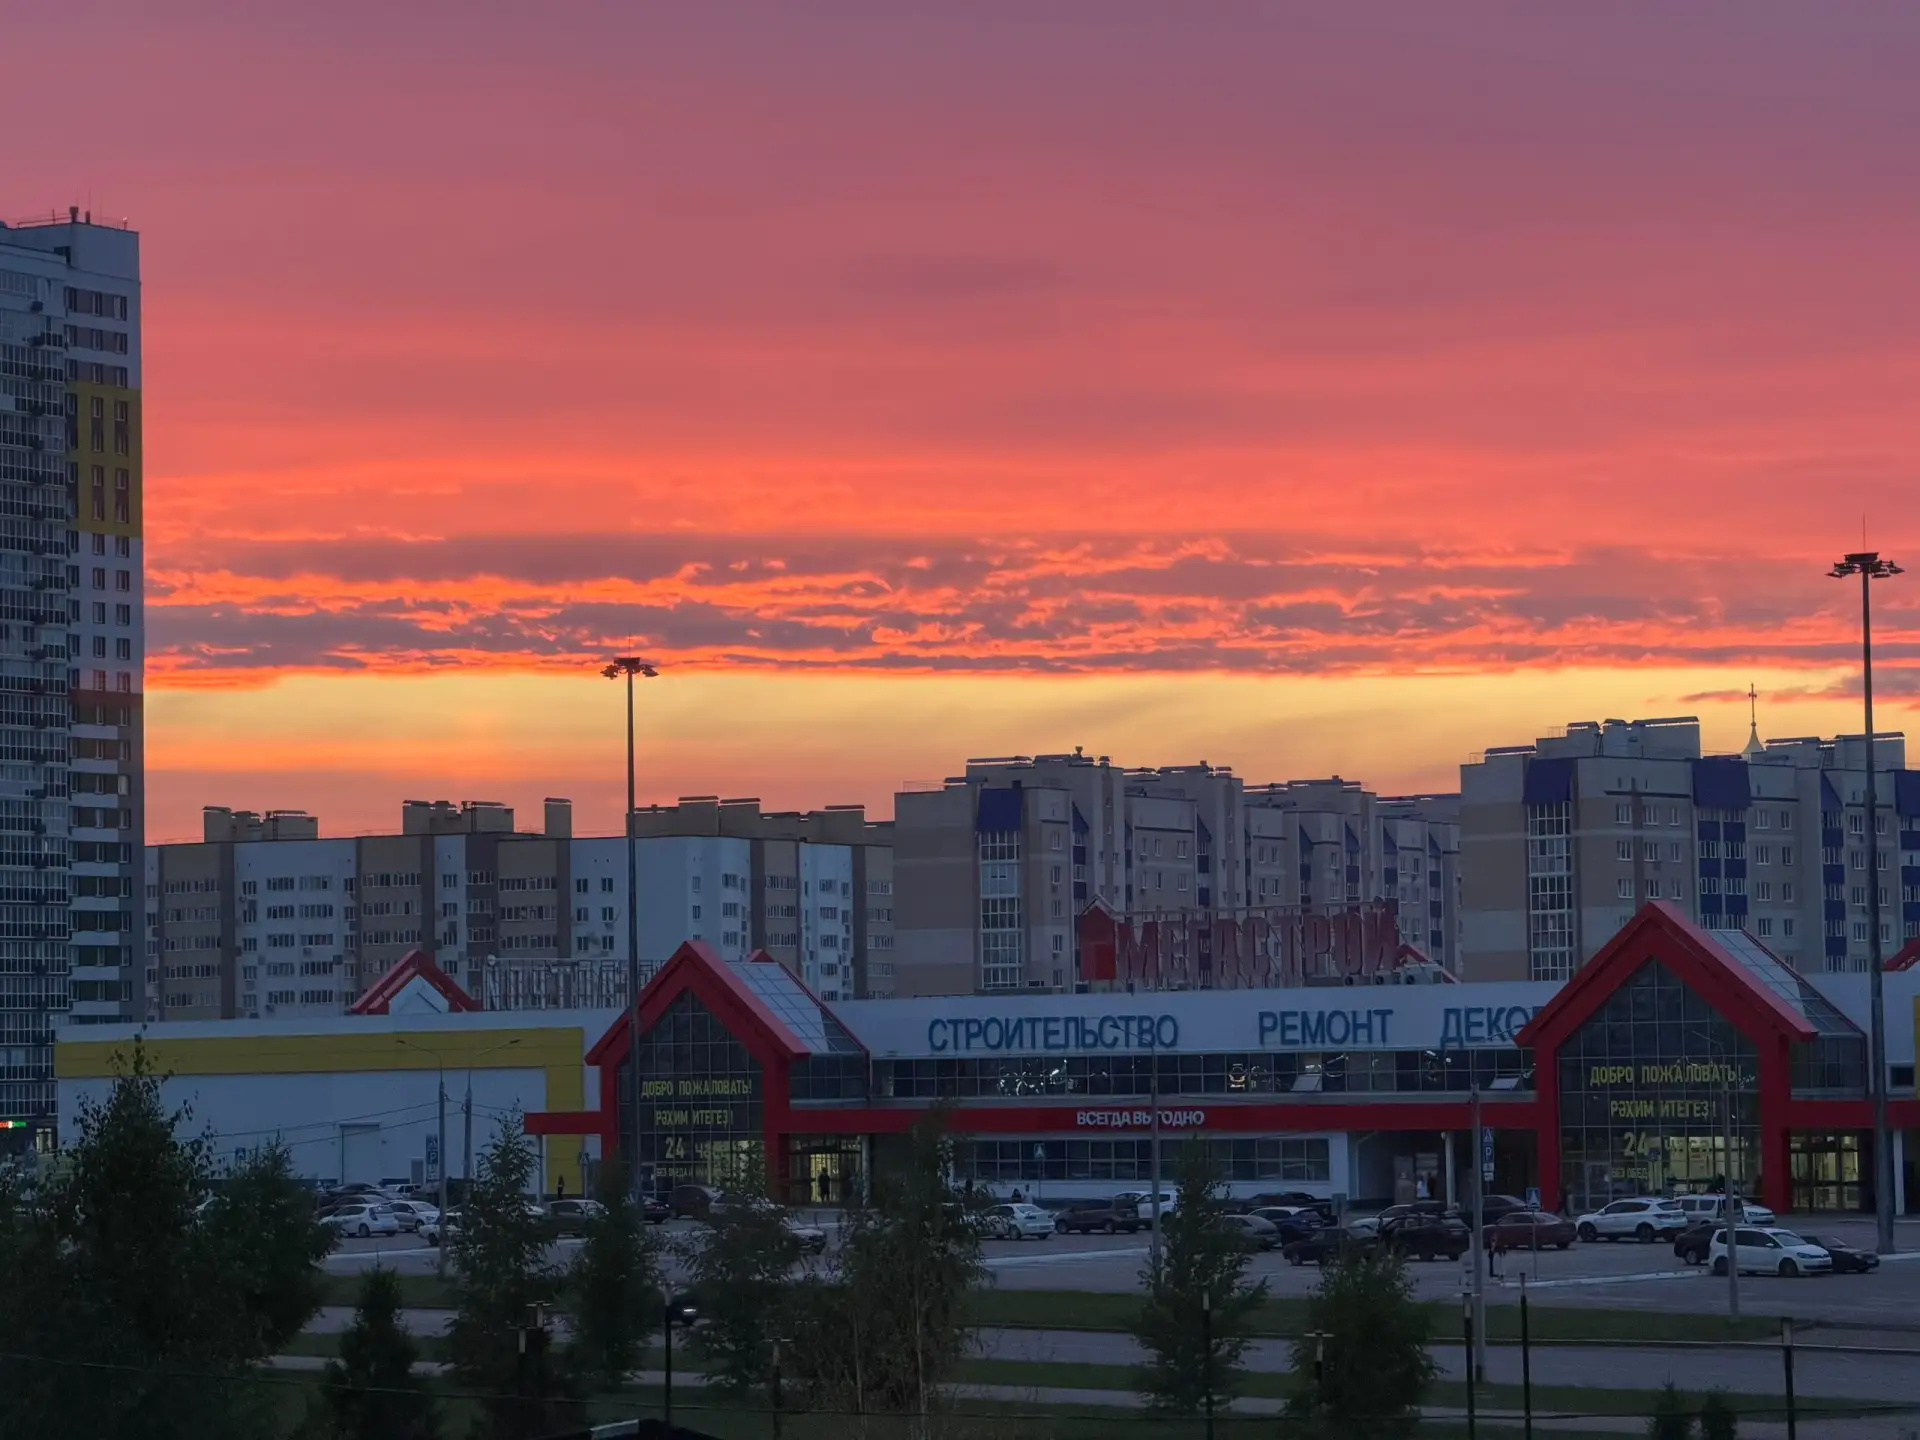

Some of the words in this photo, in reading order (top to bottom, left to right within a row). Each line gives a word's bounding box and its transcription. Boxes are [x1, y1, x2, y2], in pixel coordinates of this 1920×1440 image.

[928, 1014, 1179, 1051] СТРОИТЕЛЬСТВО
[1258, 1008, 1394, 1045] РЕМОНТ
[1590, 1065, 1634, 1088] ДОБРО
[1641, 1063, 1742, 1084] ПОЖАЛОВАТЬ!
[640, 1080, 673, 1099] ДОБРО
[678, 1078, 753, 1096] ПОЖАЛОВАТЬ!
[1076, 1110, 1132, 1128] ВСЕГДА
[664, 1136, 686, 1160] 24
[1622, 1131, 1650, 1158] 24
